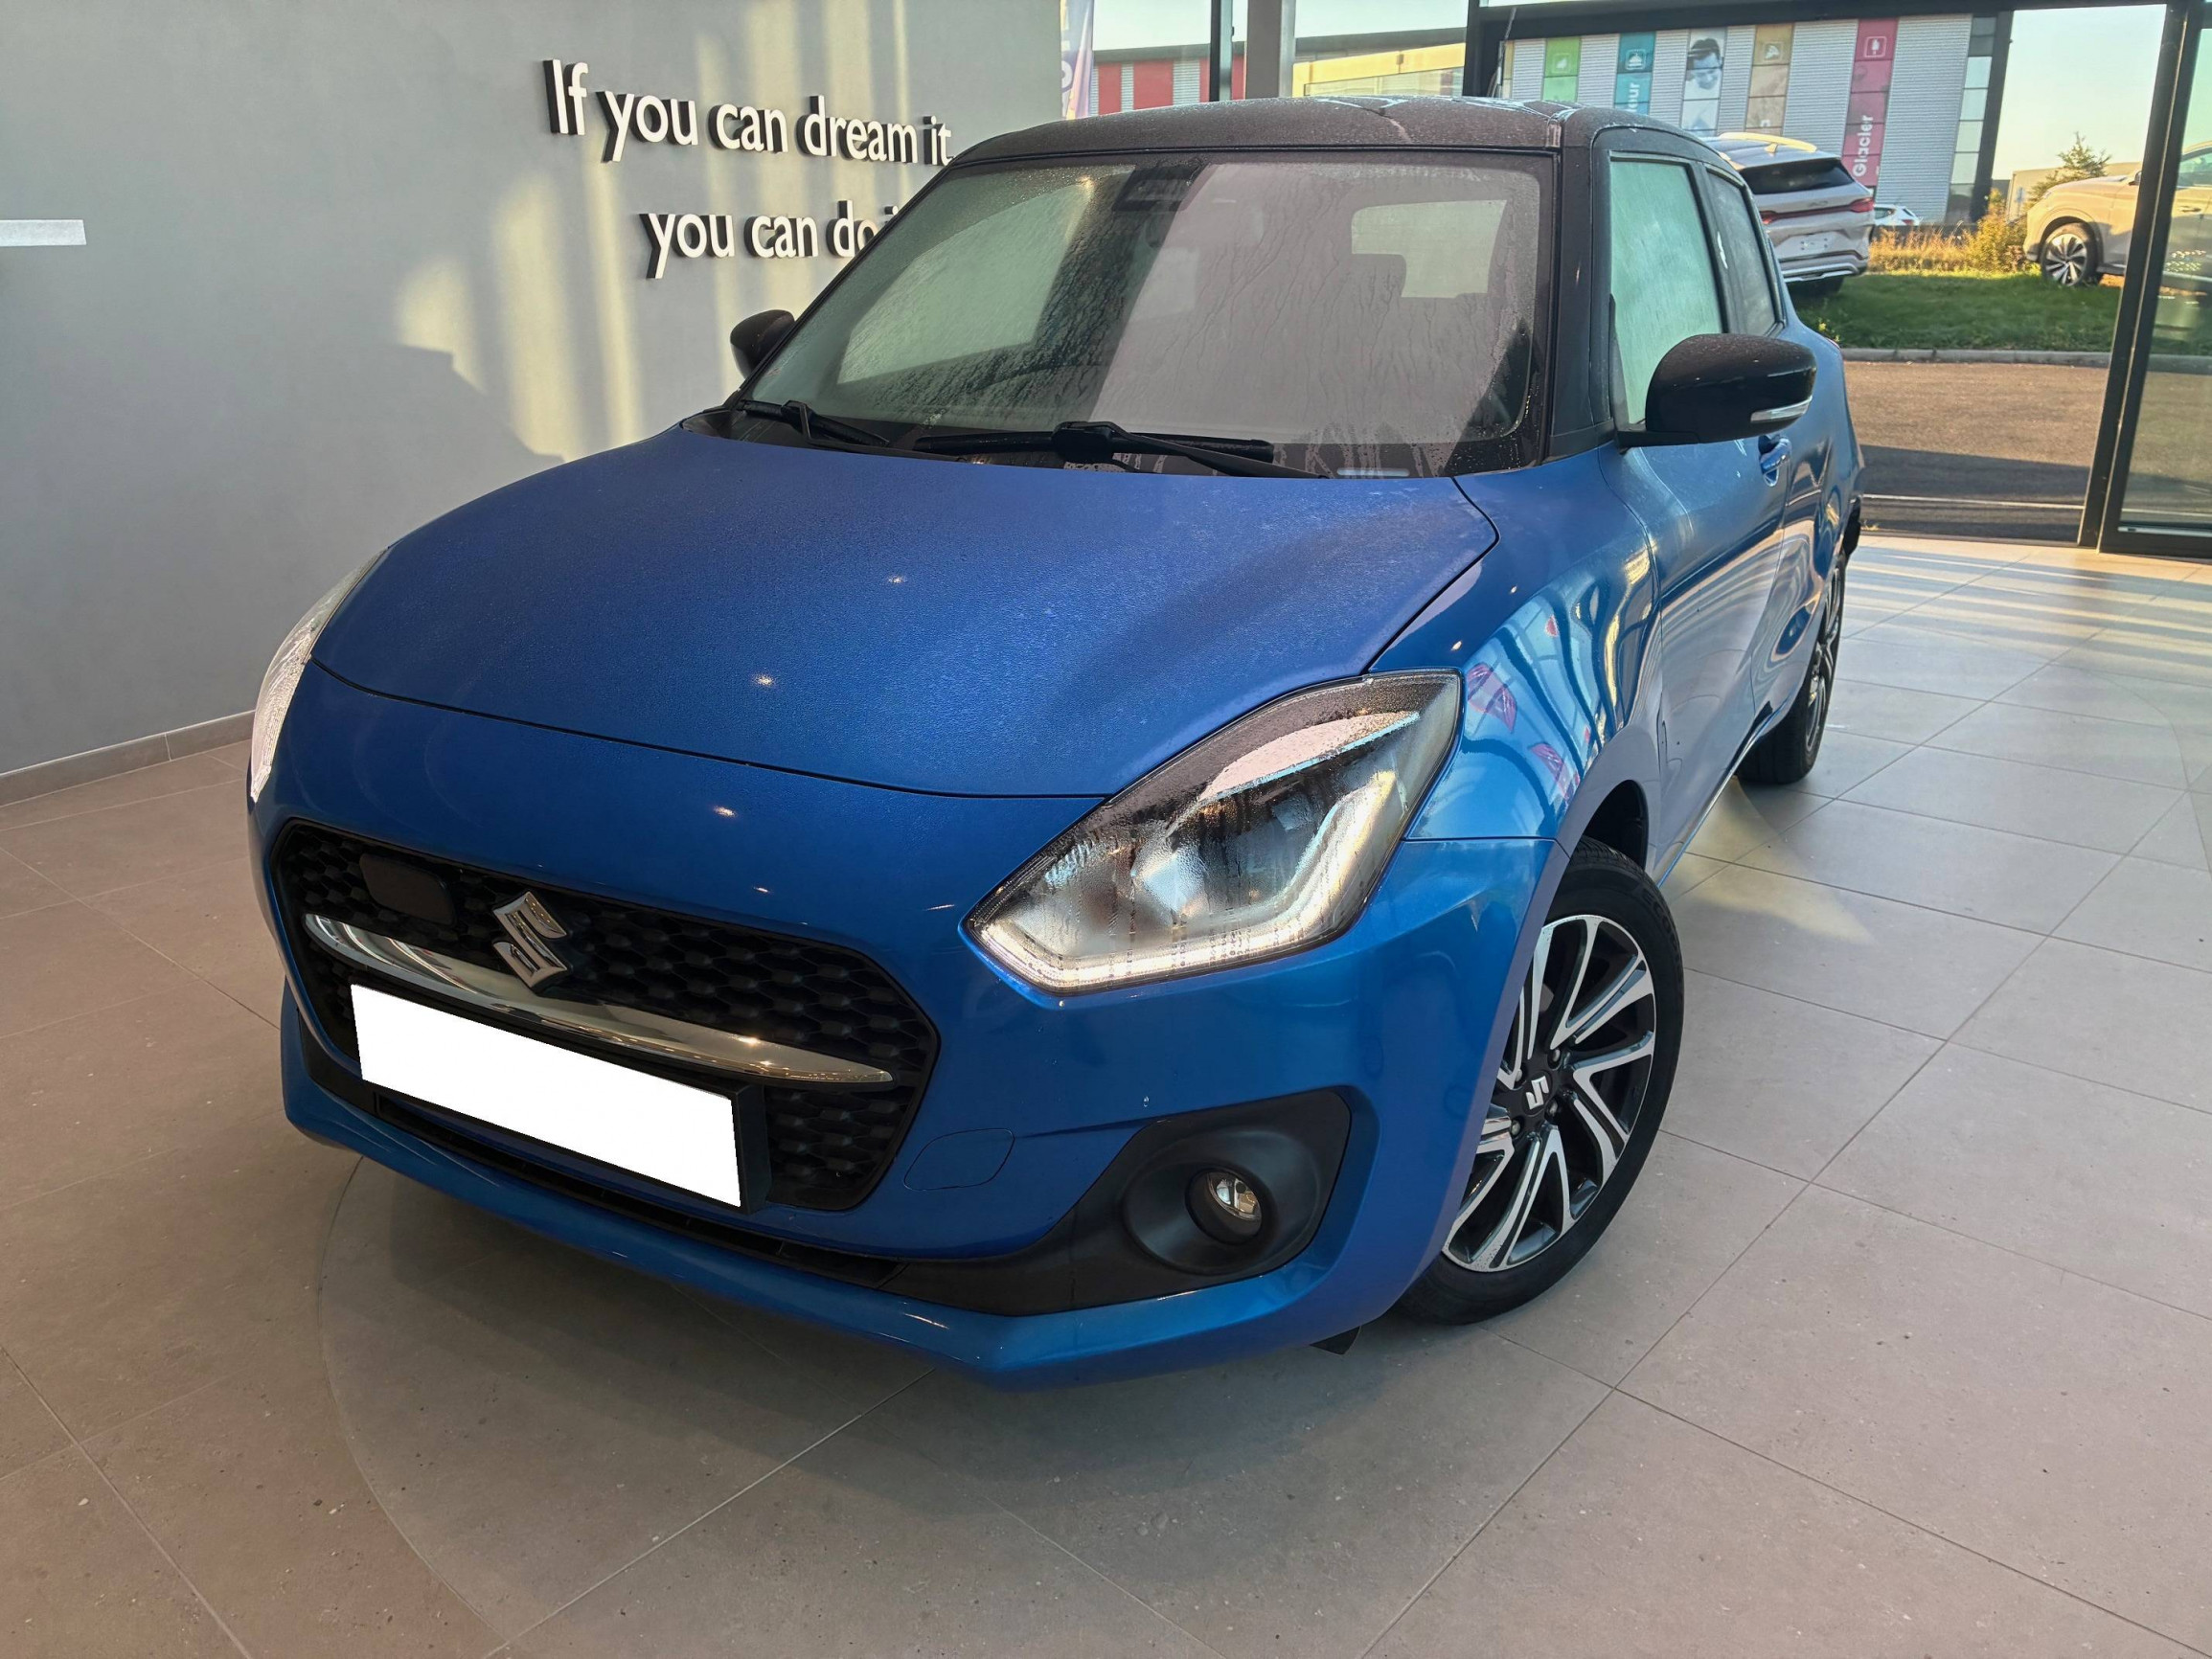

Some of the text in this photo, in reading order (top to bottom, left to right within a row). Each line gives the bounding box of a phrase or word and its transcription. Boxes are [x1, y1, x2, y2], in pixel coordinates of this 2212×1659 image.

[543, 58, 956, 166] If you can dream it
[1626, 82, 1640, 112] eur
[1853, 115, 1874, 177] Glacier
[639, 213, 735, 279] you
[744, 215, 818, 258] can
